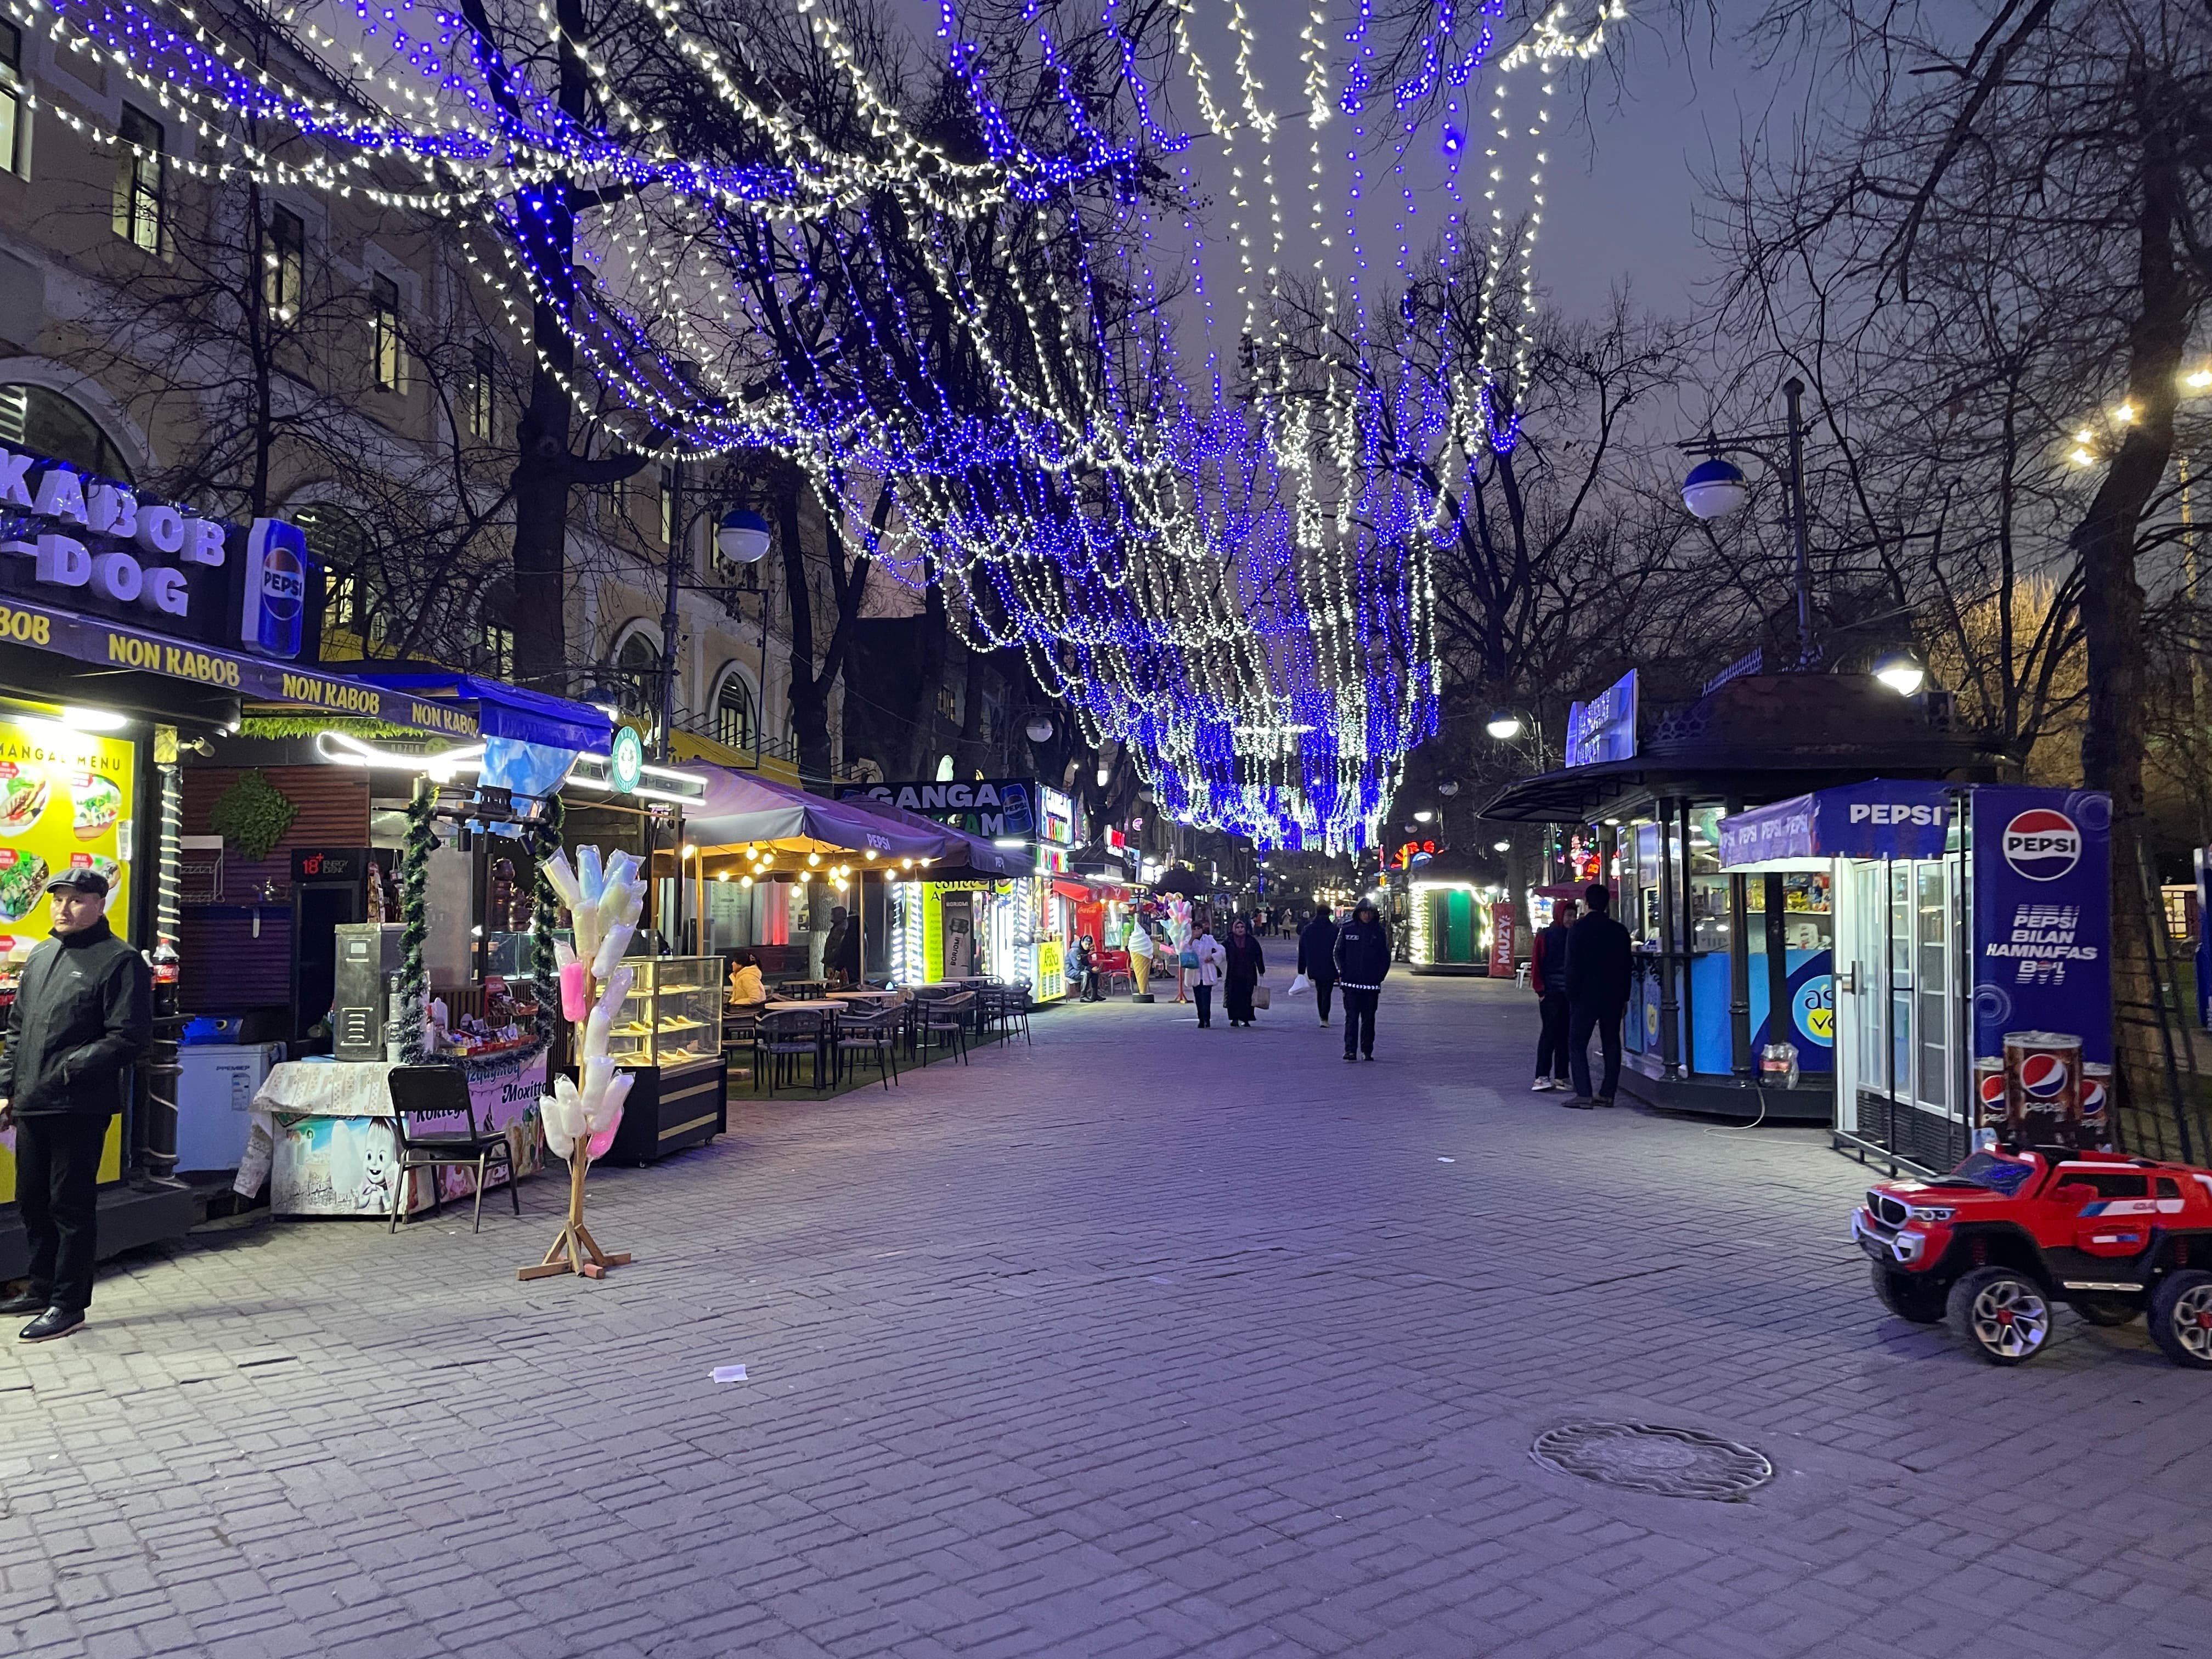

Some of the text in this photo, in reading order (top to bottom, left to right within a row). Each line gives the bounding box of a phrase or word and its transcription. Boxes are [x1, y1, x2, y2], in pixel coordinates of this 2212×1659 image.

[0, 447, 225, 567] KABOB
[264, 569, 303, 597] PEPSI
[110, 634, 240, 687] NON KABOB
[283, 673, 380, 715] NON KABOB
[412, 702, 441, 728] NON
[77, 755, 120, 770] MENU
[868, 784, 1001, 809] GANGA
[1005, 801, 1028, 812] PEPSI
[1850, 804, 1941, 826] PEPSI
[866, 833, 891, 850] PEPSI
[2008, 837, 2076, 853] PEPSI
[2013, 915, 2078, 929] PEPSI
[1498, 916, 1510, 964] MUZY
[2011, 929, 2075, 944] BILAN
[950, 937, 961, 966] BORJOMI
[1986, 943, 2098, 960] HAMNAFAS
